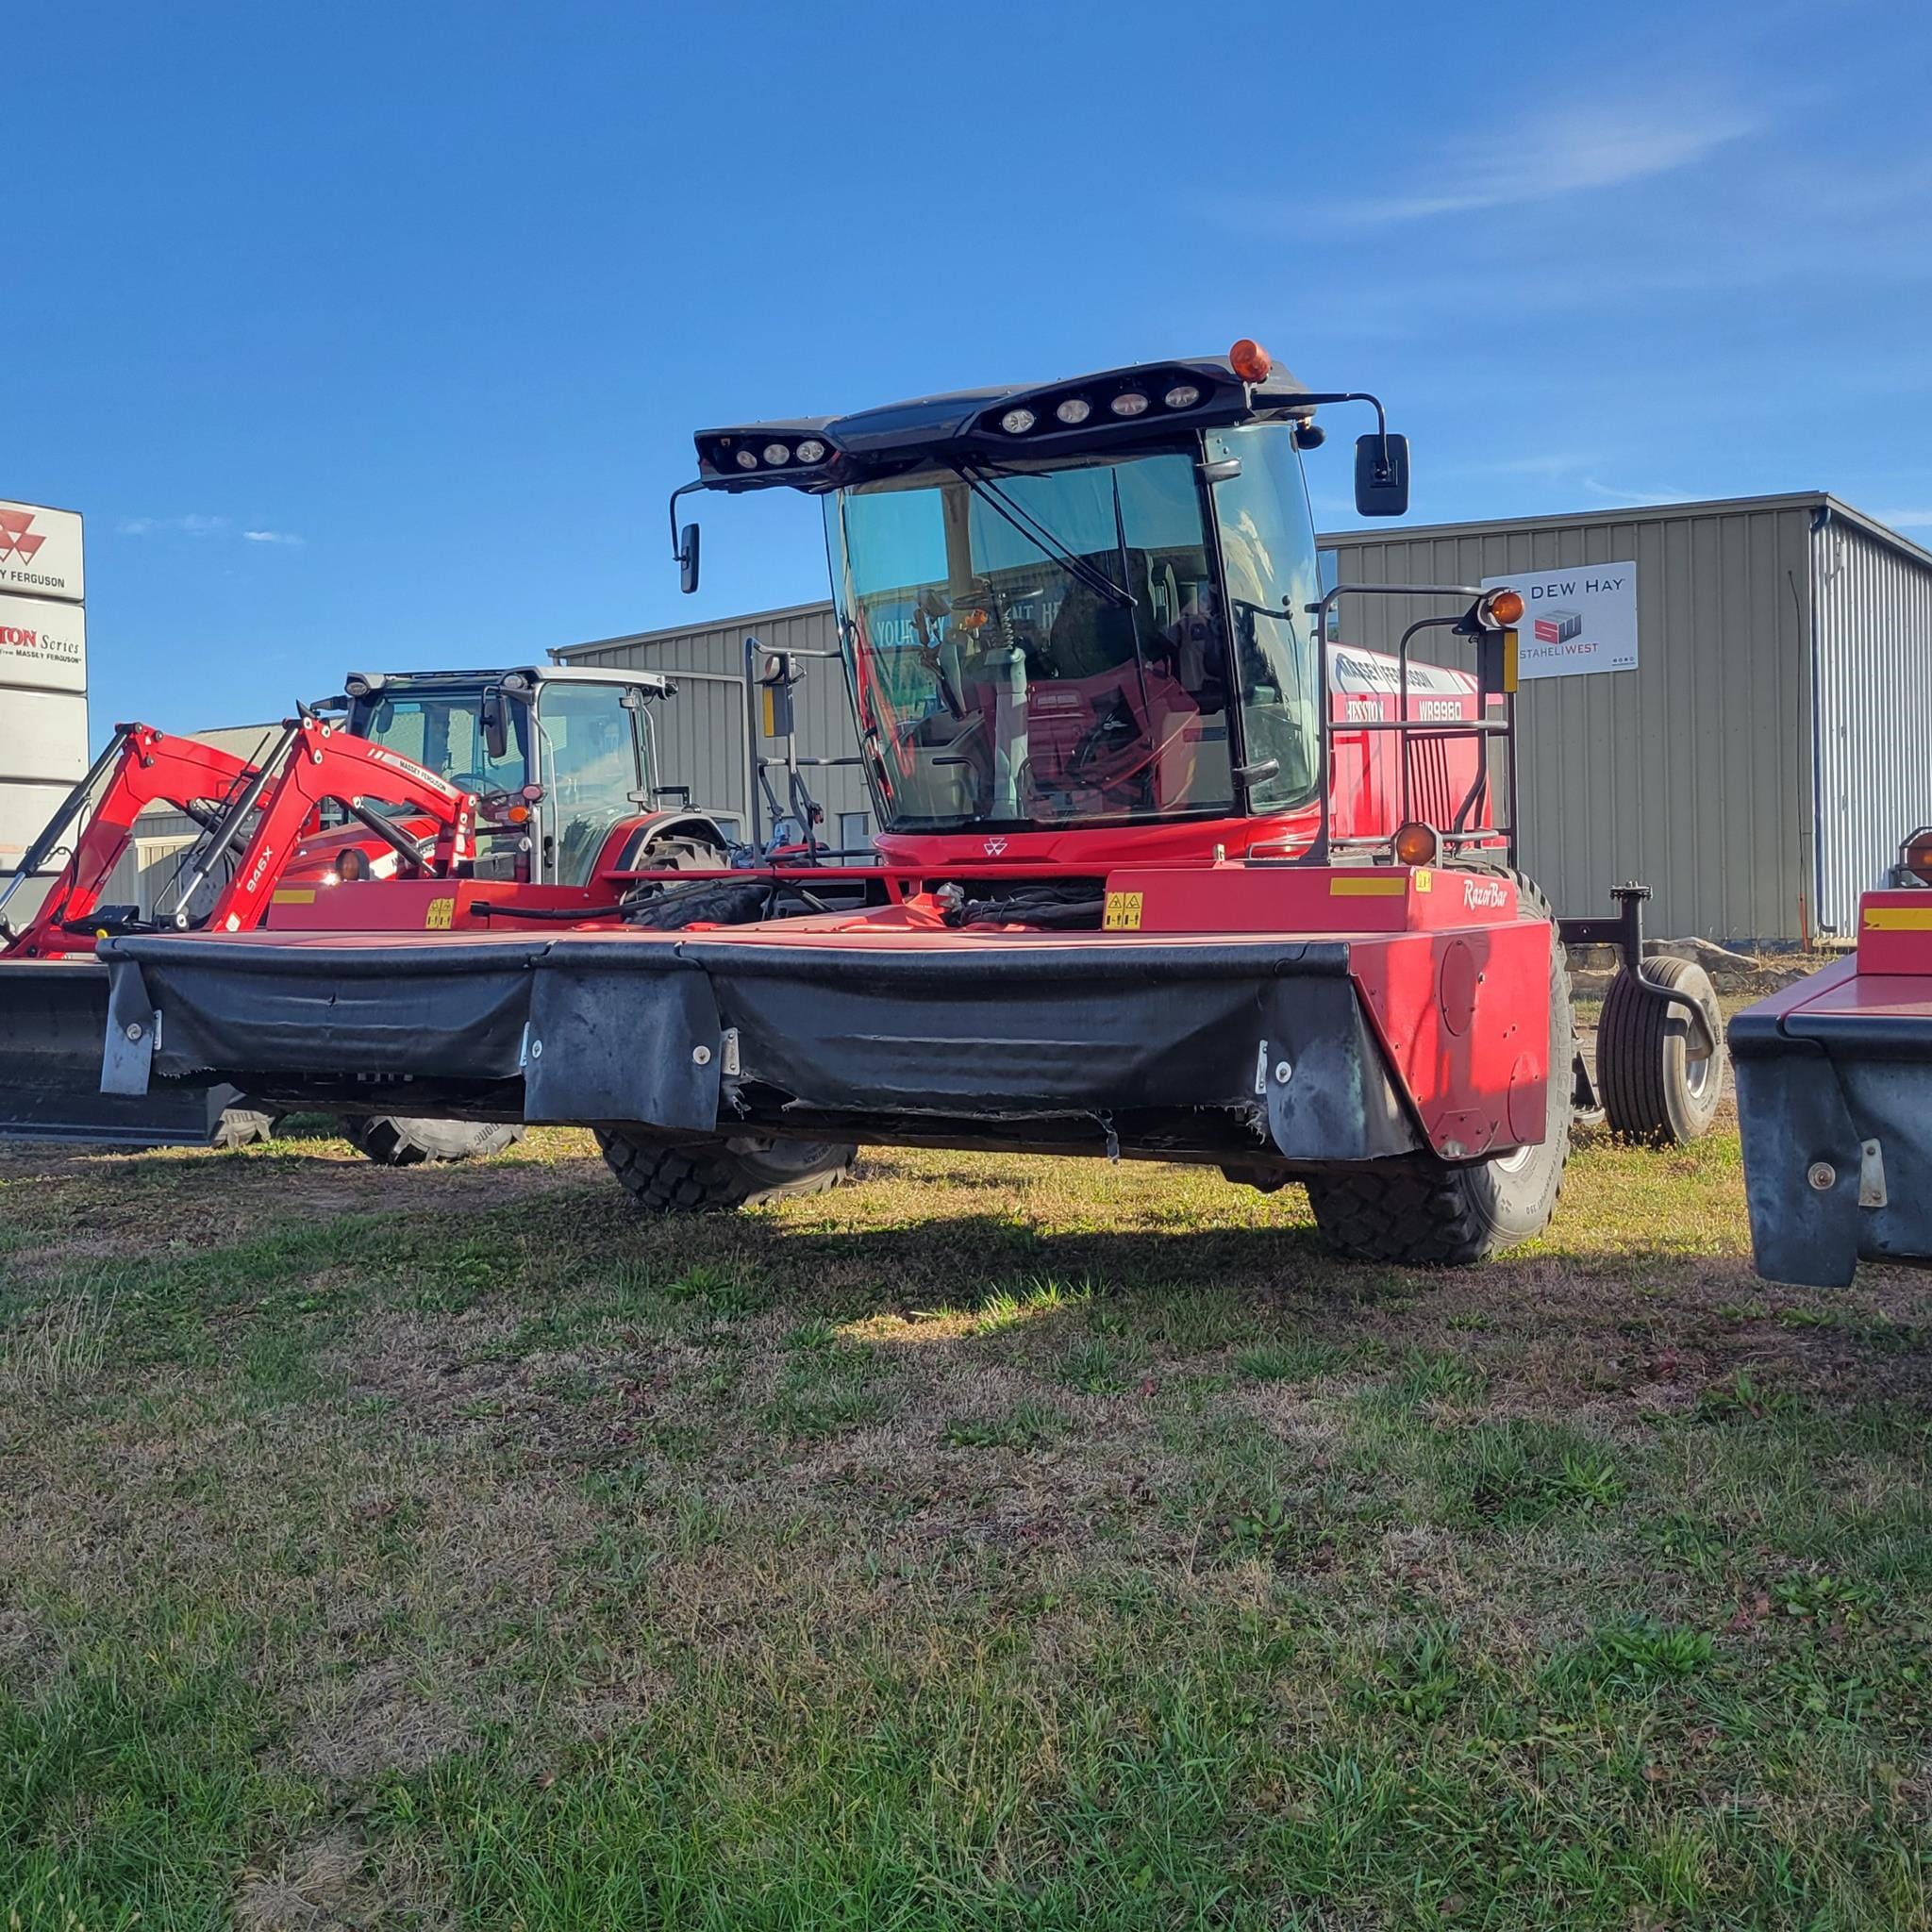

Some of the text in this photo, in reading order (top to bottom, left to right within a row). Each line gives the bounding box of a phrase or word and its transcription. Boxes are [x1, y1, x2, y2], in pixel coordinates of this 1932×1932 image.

[10, 571, 65, 589] FERGUSON
[1531, 578, 1624, 600] DEW HAY
[41, 634, 79, 655] Series
[1520, 642, 1599, 659] STAHELIWEST
[16, 649, 44, 659] MASSEY
[46, 653, 79, 664] FERGUSON
[1338, 658, 1383, 681] MASSEY
[399, 760, 447, 792] MASSEY FERGUSON
[246, 844, 273, 894] 946X
